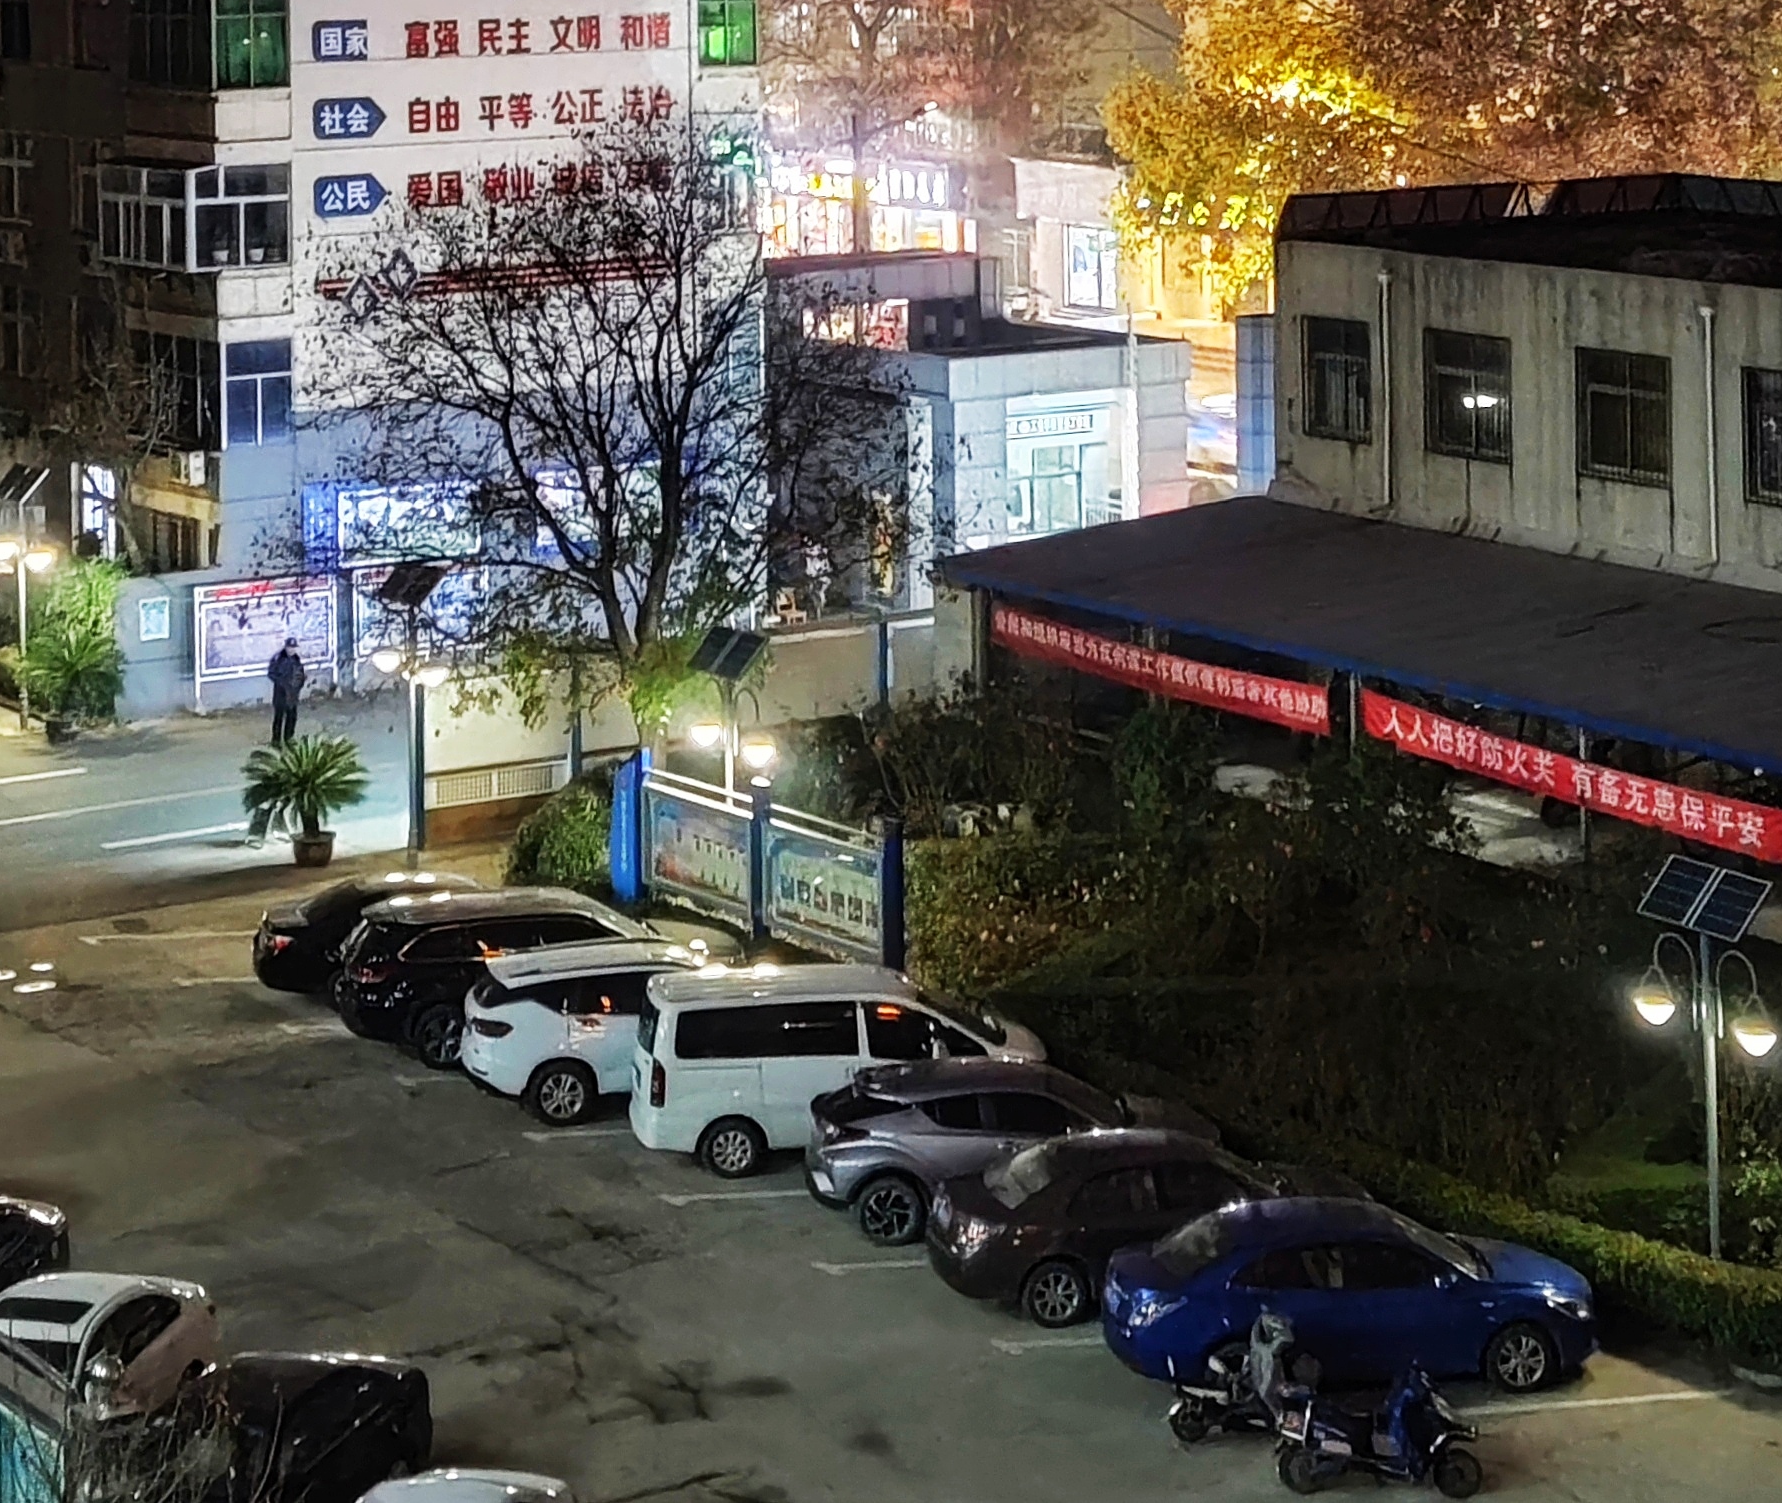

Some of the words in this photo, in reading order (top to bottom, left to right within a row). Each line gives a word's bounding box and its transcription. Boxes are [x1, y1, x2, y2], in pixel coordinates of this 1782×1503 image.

[319, 22, 368, 57] 国家
[405, 20, 459, 58] 富强
[478, 18, 531, 55] 民主
[550, 15, 601, 51] 文明
[620, 12, 671, 49] 和谐
[320, 106, 370, 136] 社会
[407, 97, 460, 133] 自由
[478, 93, 533, 128] 平等
[551, 89, 606, 124] 公正
[621, 85, 674, 122] 法治
[321, 179, 371, 213] 公民
[408, 170, 463, 207] 爱国
[484, 167, 536, 204] 敬业
[1382, 706, 1556, 787] 人人把好防火关
[1571, 763, 1768, 848] 有备无患保平安
